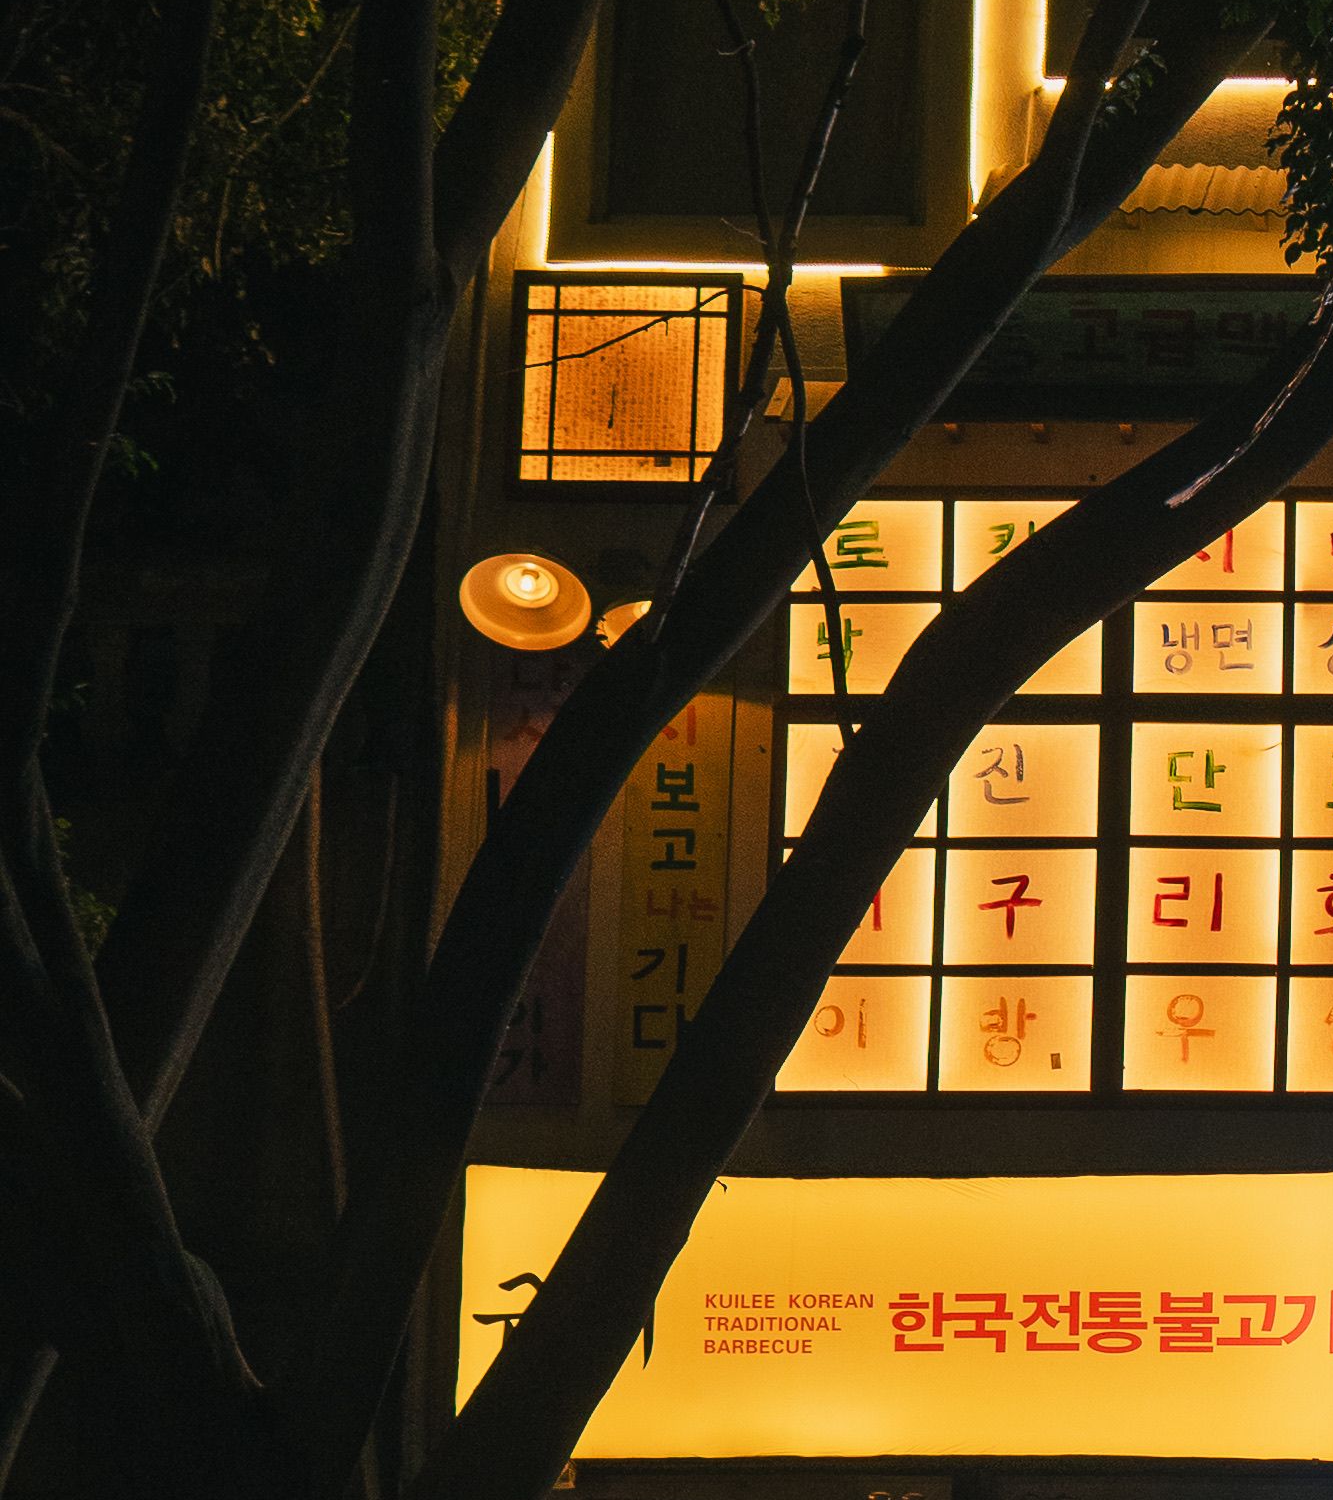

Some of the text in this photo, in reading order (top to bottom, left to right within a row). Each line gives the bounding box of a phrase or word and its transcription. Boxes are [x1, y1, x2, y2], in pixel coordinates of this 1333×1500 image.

[1160, 617, 1255, 677] 냉면
[1166, 749, 1227, 813] 단
[1151, 874, 1224, 936] 리
[704, 1293, 875, 1309] KUILEE KOREAN
[703, 1316, 842, 1332] TRADITIONAL
[703, 1339, 813, 1355] BARBECUE
